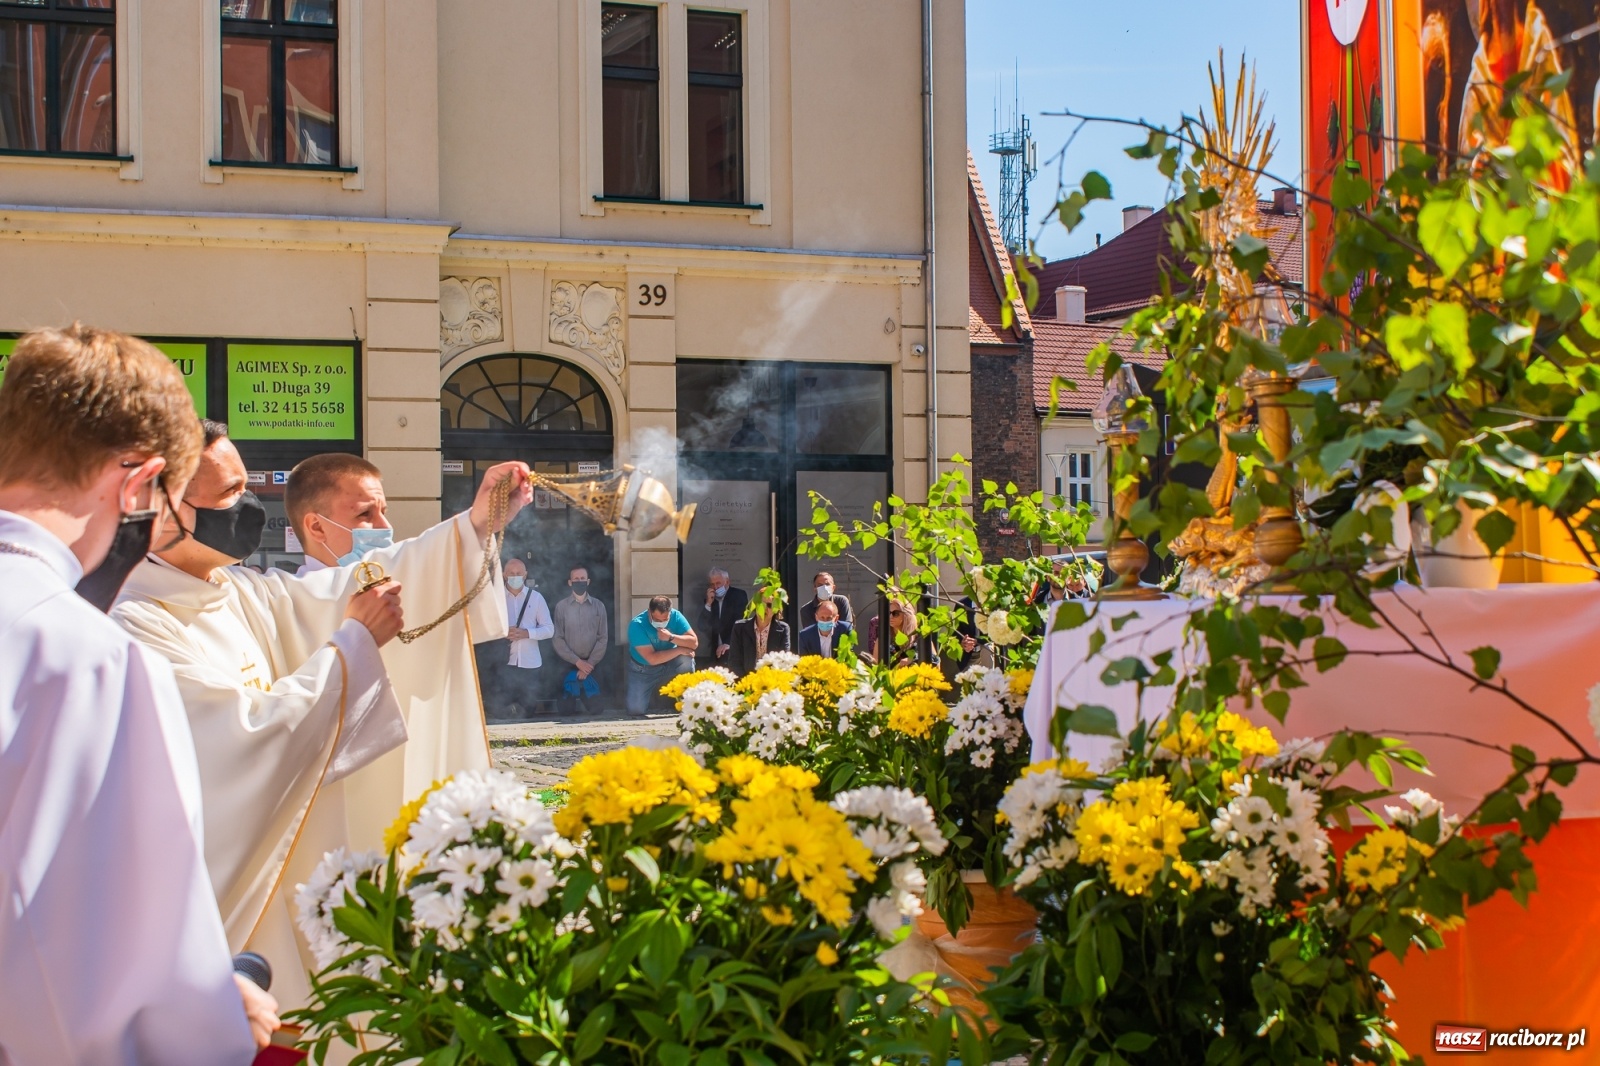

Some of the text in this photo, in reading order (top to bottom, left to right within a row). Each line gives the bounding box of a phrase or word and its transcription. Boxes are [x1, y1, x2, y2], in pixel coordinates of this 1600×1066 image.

[638, 283, 667, 306] 39
[235, 360, 347, 377] AGIMEX Sp. z o.o.
[252, 381, 331, 397] ul. Długa 39
[238, 400, 345, 415] tel. 32 415 5658
[248, 419, 335, 429] www.podatki-info.eu
[714, 500, 753, 510] dietetyka
